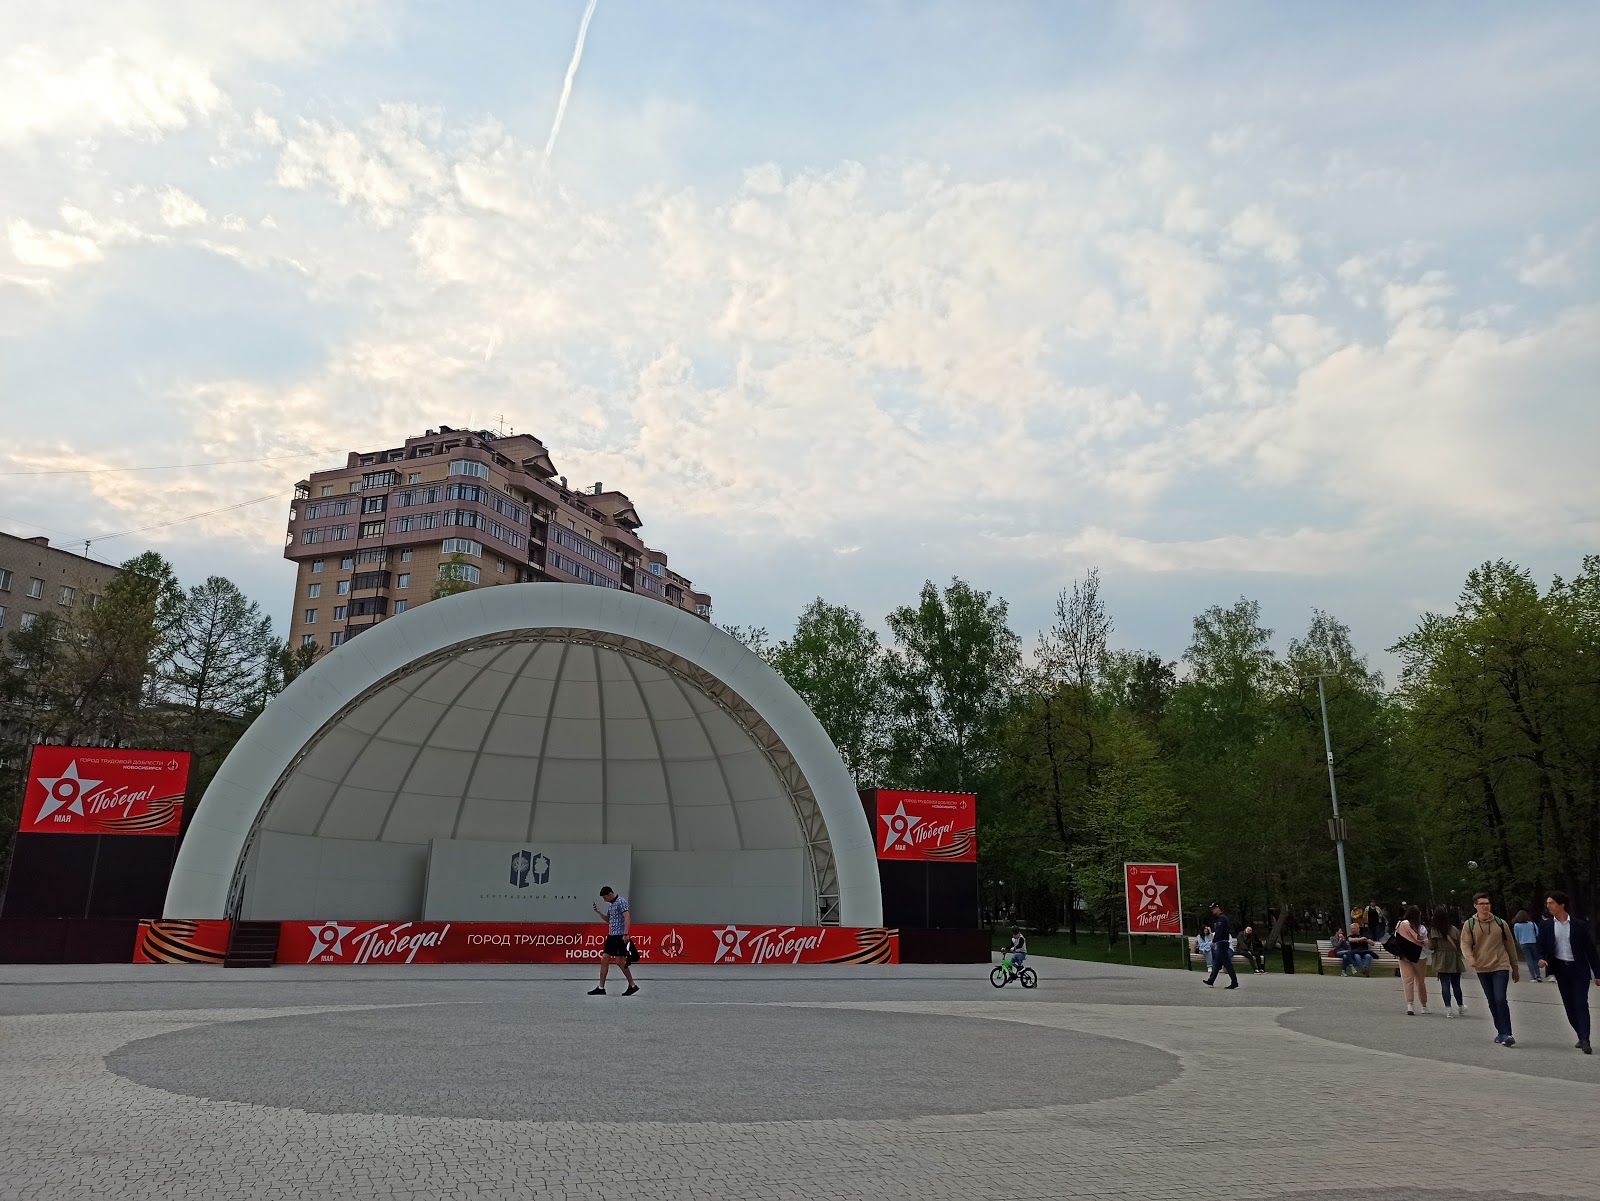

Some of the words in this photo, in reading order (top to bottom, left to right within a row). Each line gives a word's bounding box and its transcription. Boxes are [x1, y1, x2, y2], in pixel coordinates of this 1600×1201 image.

[52, 777, 80, 812] 9
[87, 785, 155, 818] Победа!
[53, 814, 71, 823] МАЯ
[891, 815, 909, 840] 9
[912, 820, 954, 847] Победа!
[1144, 885, 1158, 904] 9
[1137, 910, 1170, 930] Победа!
[318, 926, 340, 953] 9
[352, 922, 450, 964] Победа!
[467, 935, 511, 946] ГОРОД
[514, 933, 583, 946] ТРУДОВОЙ
[585, 935, 652, 946] ДОСТИ
[721, 930, 738, 955] 9
[748, 927, 826, 964] Победа!
